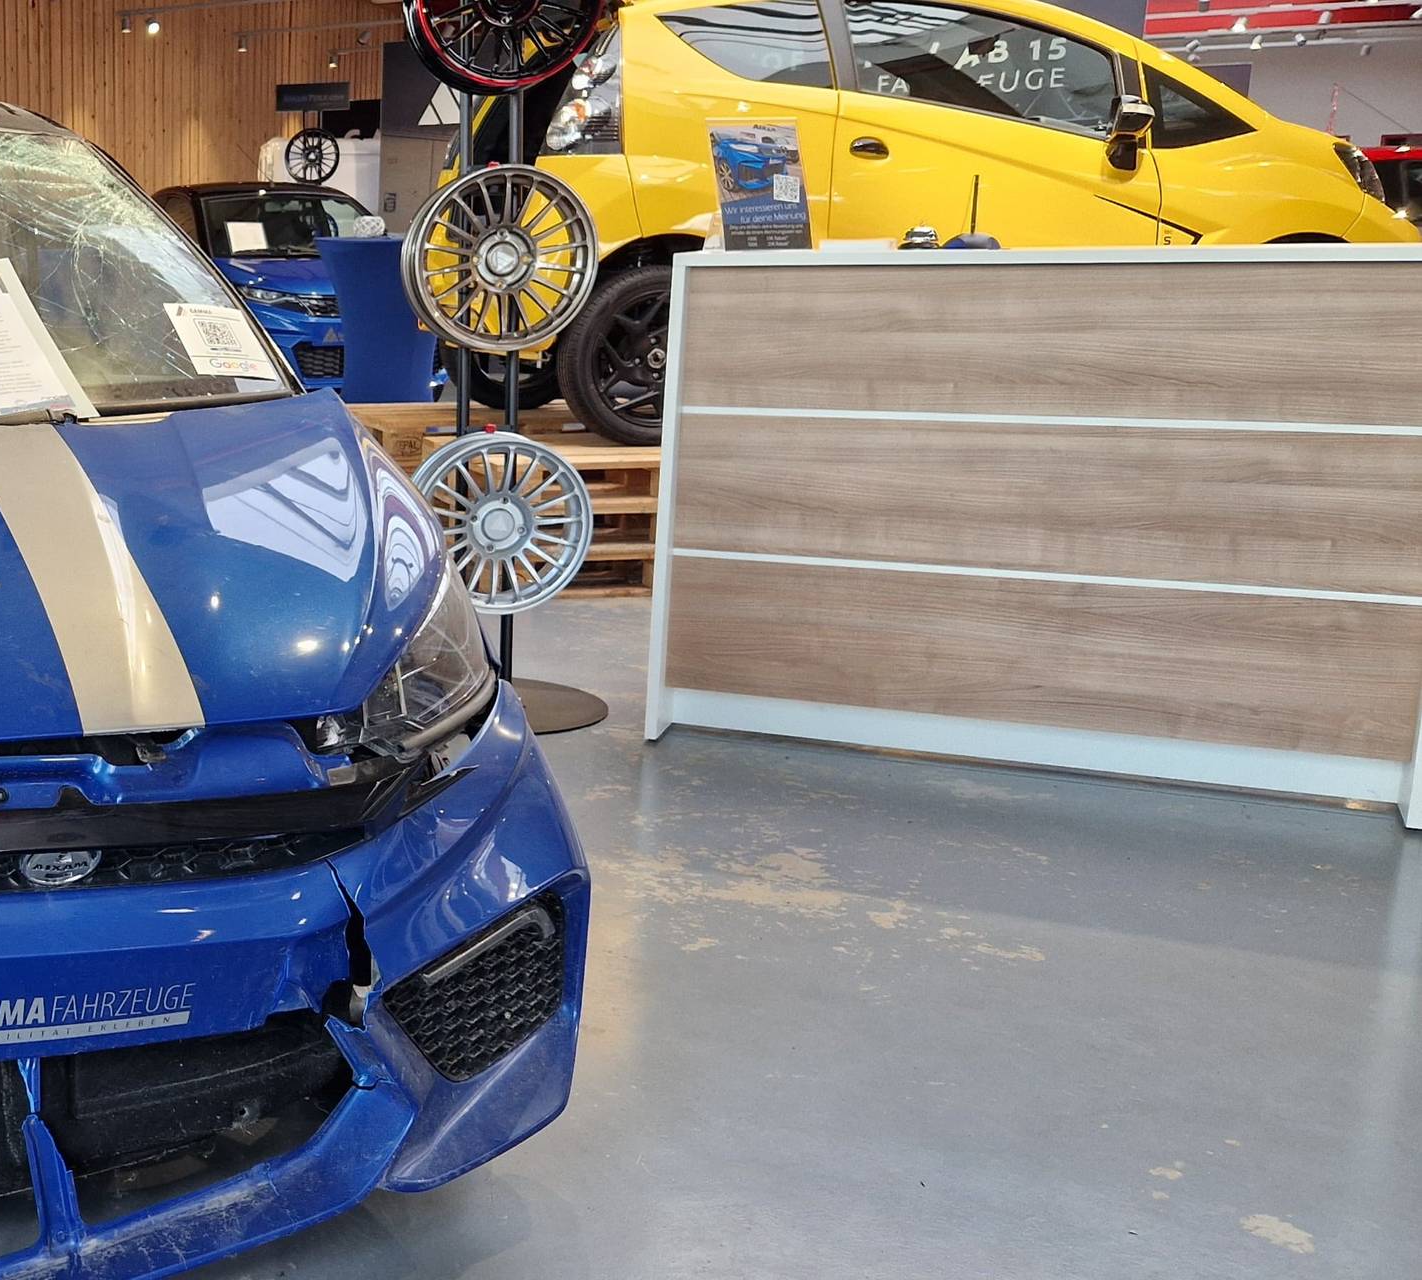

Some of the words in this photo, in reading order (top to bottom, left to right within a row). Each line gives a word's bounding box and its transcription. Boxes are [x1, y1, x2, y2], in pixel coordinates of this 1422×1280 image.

[1030, 37, 1067, 61] 15
[209, 358, 259, 373] Google
[88, 1015, 172, 1034] ERLEBEN
